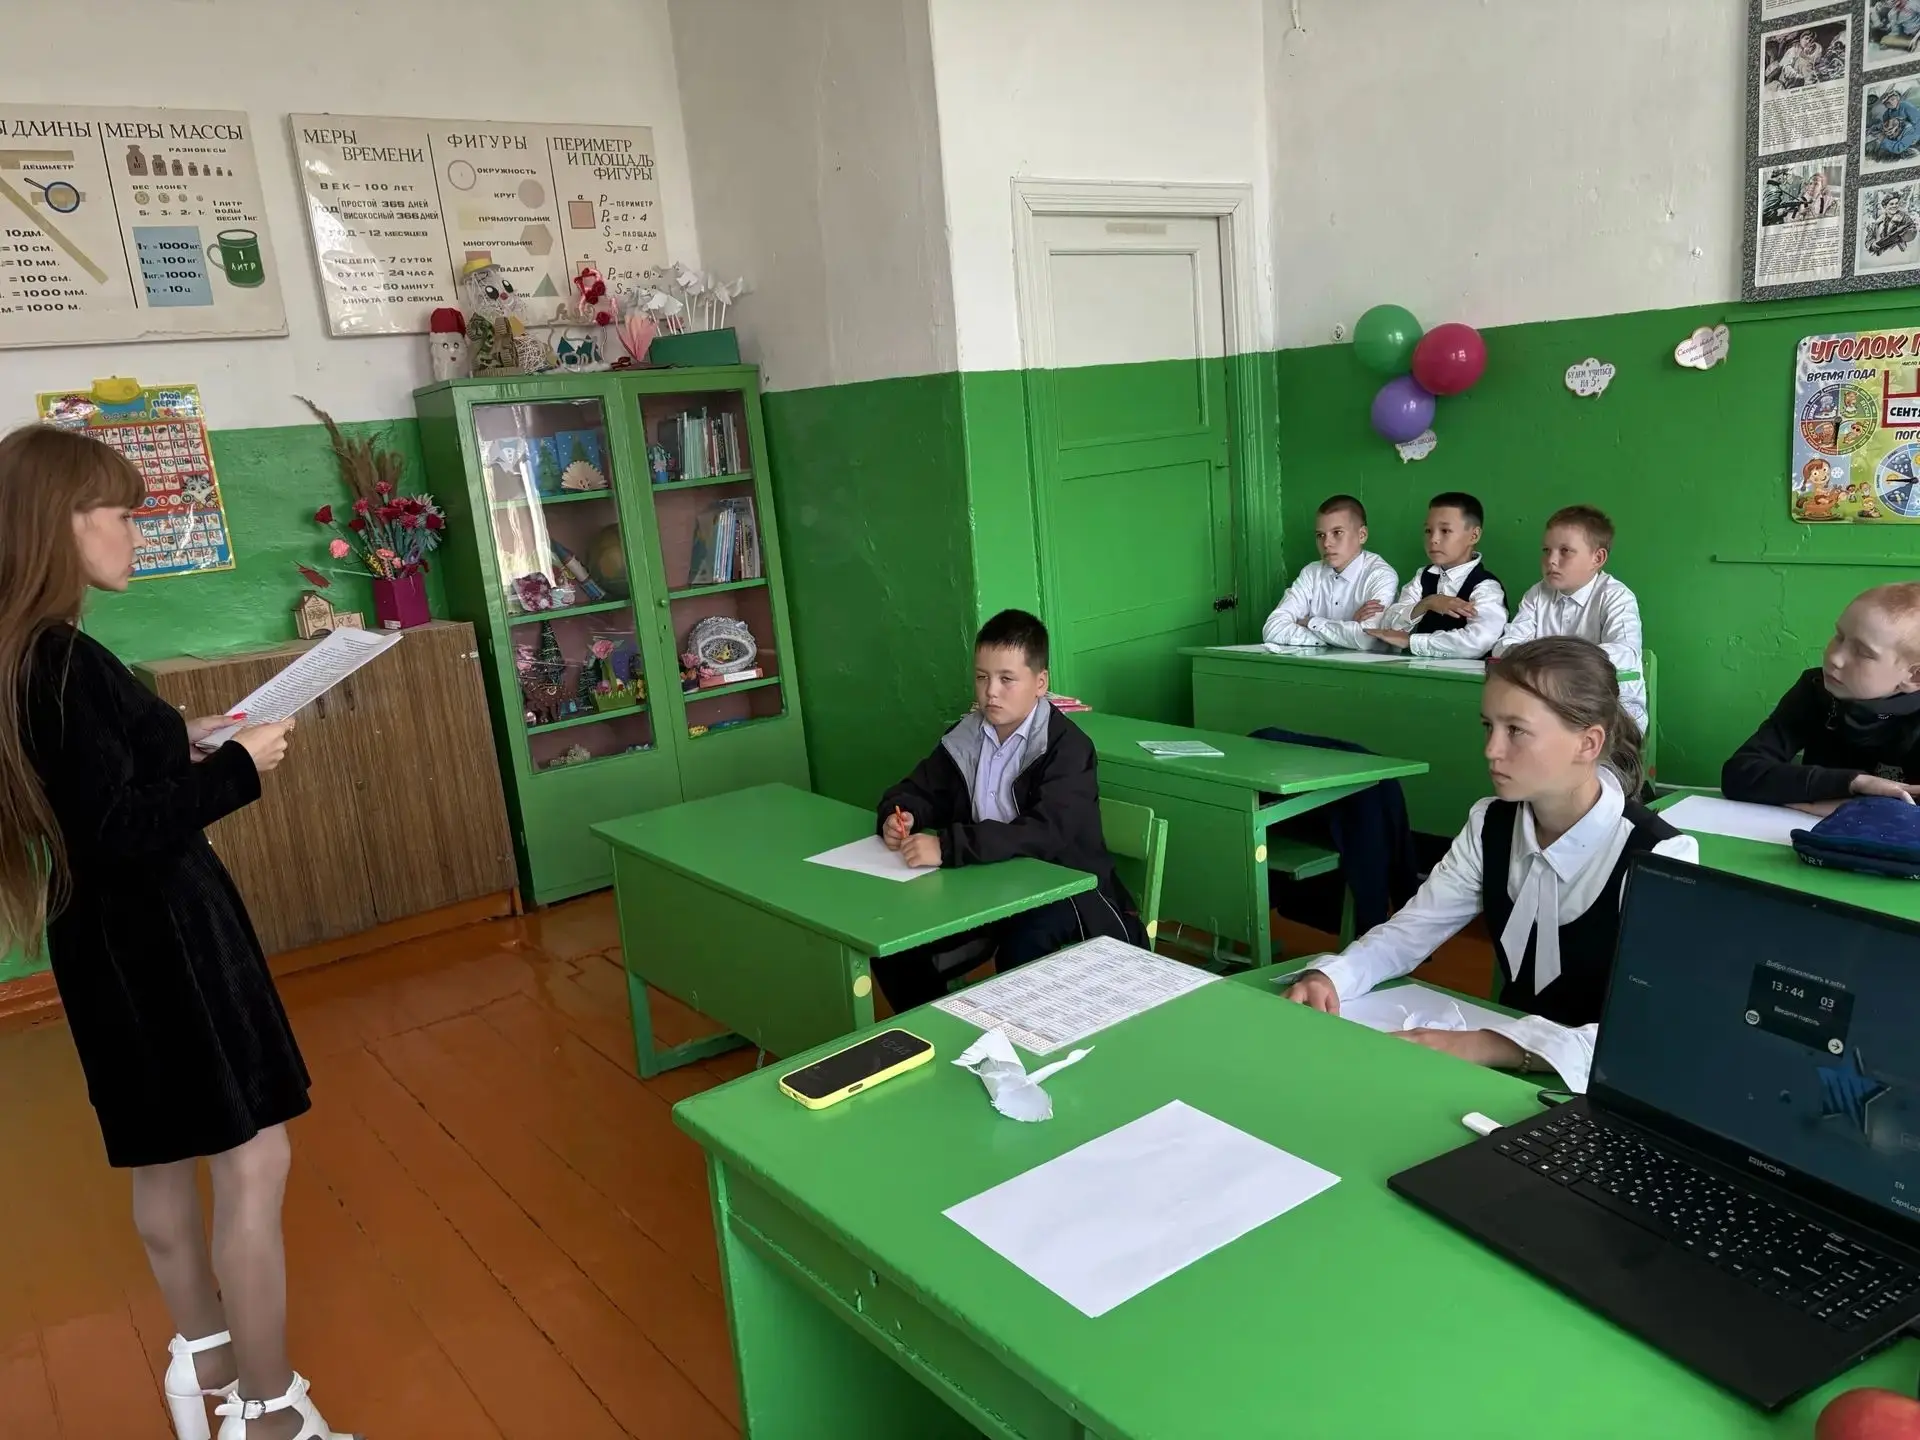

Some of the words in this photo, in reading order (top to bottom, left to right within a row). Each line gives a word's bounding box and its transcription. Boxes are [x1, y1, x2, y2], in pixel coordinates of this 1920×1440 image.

[12, 120, 92, 138] ДЛИНЫ
[104, 122, 164, 139] МЕРЫ
[169, 124, 244, 140] МАССЫ
[303, 129, 357, 145] МЕРЫ
[447, 133, 528, 150] ФИГУРЫ
[553, 137, 632, 152] ПЕРИМЕТР
[341, 146, 425, 163] ВРЕМЕНИ
[567, 152, 579, 165] И
[581, 152, 654, 168] ПЛОЩАДЬ
[476, 167, 537, 175] ОКРУЖНОСТЬ
[593, 167, 653, 181] ФИГУРЫ
[320, 182, 350, 191] ВЕК
[365, 183, 389, 191] 100
[341, 199, 378, 208] ПРОСТОЙ
[408, 199, 429, 208] ДНЕЙ
[343, 210, 395, 220] ВИСОКОСНЫЙ
[420, 211, 439, 220] ДНЕЙ
[622, 230, 657, 238] ПЛОЩАДЬ
[13, 244, 29, 252] 10
[17, 259, 33, 267] 10
[334, 257, 377, 265] НЕДЕЛЯ
[231, 262, 256, 271] ЛИТР
[20, 275, 48, 283] 100
[401, 283, 435, 291] МИНУТ
[24, 289, 61, 297] 1000
[27, 303, 64, 312] 1000
[1810, 334, 1908, 362] УГОЛОК
[1807, 372, 1845, 382] ВРЕМЯ
[1847, 368, 1876, 380] ГОДА
[1820, 996, 1835, 1009] 03
[1894, 1181, 1905, 1191] EN
